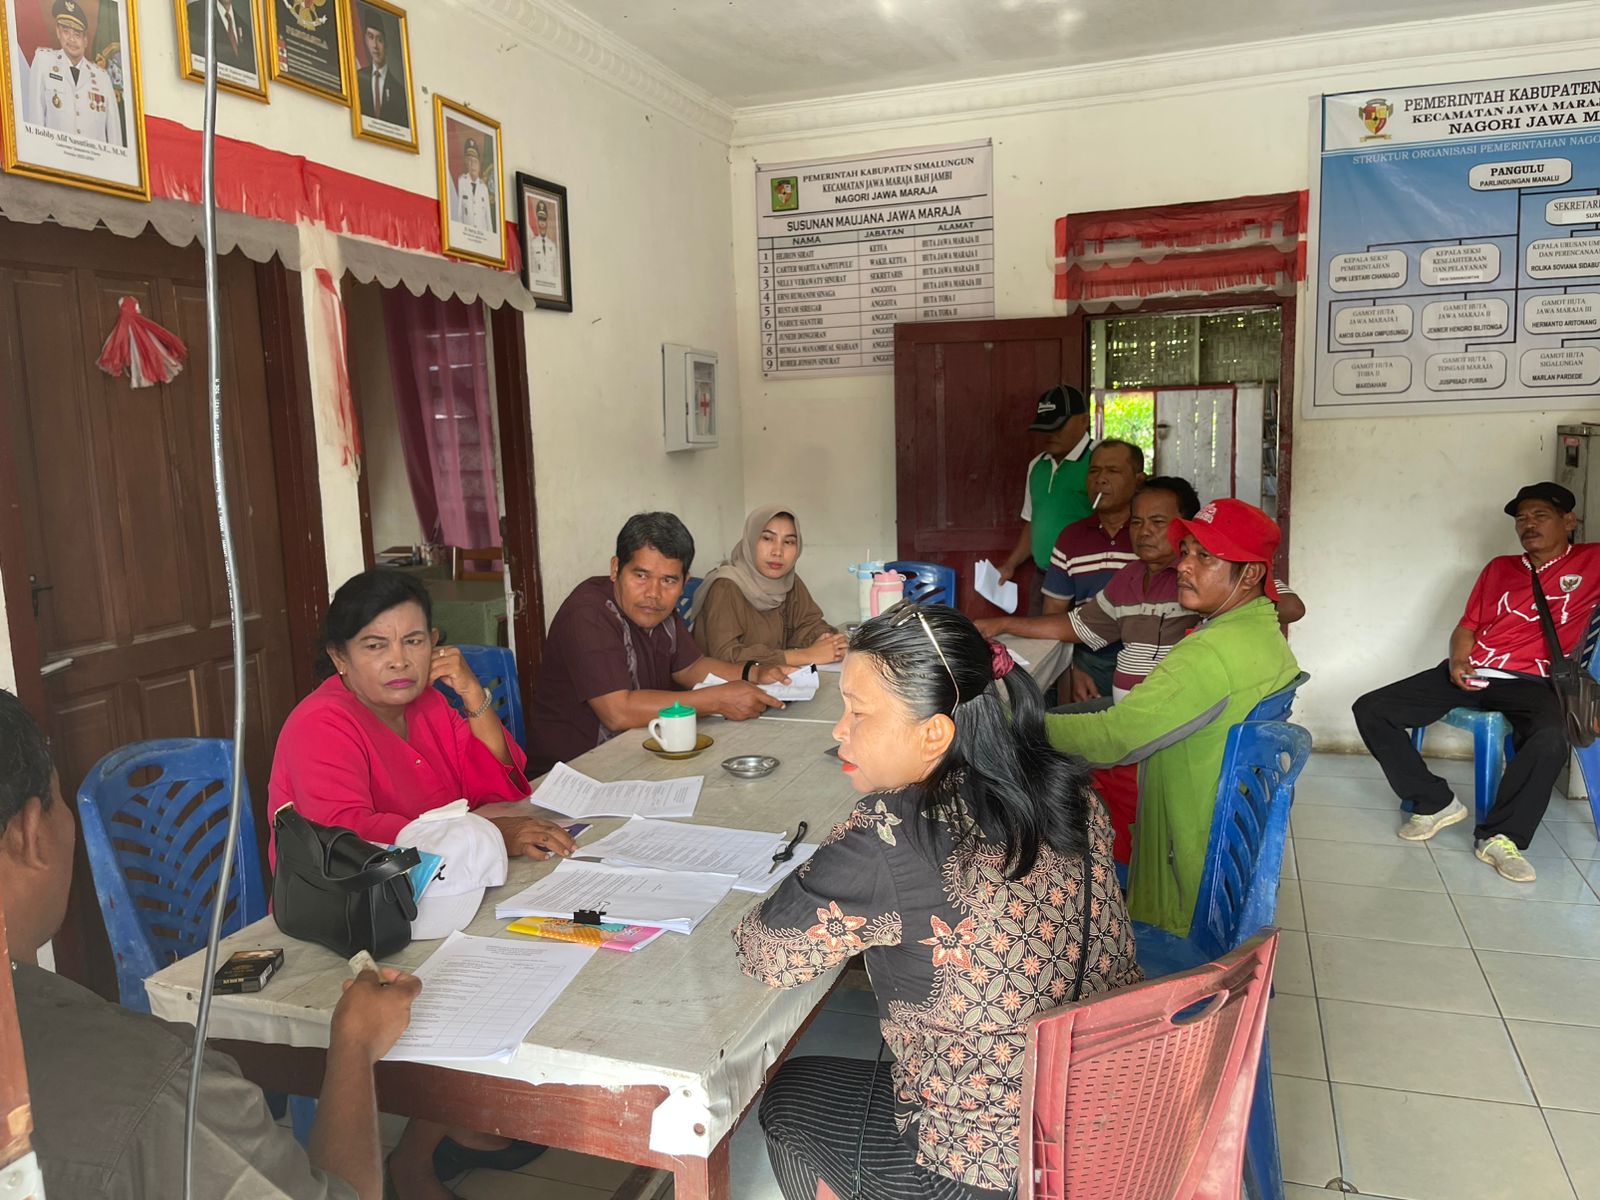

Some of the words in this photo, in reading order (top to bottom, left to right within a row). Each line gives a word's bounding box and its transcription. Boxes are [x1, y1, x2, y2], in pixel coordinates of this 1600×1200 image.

[1404, 88, 1504, 112] PEMERINTAH
[1510, 80, 1600, 102] KABUPATEN
[1412, 107, 1506, 123] KECAMATAN
[1507, 103, 1548, 115] JAWA
[1448, 118, 1520, 135] NAGORI
[1526, 114, 1576, 128] JAWA
[36, 128, 54, 140] Bobby
[1353, 152, 1409, 164] STRUKTUR
[1412, 146, 1477, 159] ORGANISASI
[1480, 138, 1567, 153] PEMERINTAHAN
[803, 170, 858, 183] PEMERINTAH
[860, 164, 912, 176] KABUPATEN
[914, 157, 974, 170] SIMALUNGUN
[1491, 164, 1544, 176] PANGULU
[822, 178, 865, 193] KECAMATAN
[866, 178, 884, 190] JAWA
[885, 175, 914, 186] MARAJA
[915, 174, 930, 184] BAH
[931, 171, 952, 183] JAMBI
[1480, 177, 1530, 187] PARLINDUNGAN
[835, 193, 870, 204] NAGORI
[872, 191, 898, 200] JAWA
[900, 186, 938, 197] MARAJA
[787, 218, 834, 232] SUSUNAN
[836, 214, 884, 228] MAUJANA
[887, 210, 916, 222] JAWA
[918, 205, 961, 219] MARAJA
[938, 222, 974, 231] ALAMAT
[864, 228, 904, 238] JABATAN
[792, 236, 821, 245] NAMA
[953, 236, 974, 245] MARAJA
[953, 250, 974, 259] MARAJA
[1340, 263, 1390, 271] PEMERINTAHAN
[764, 280, 769, 289] 3
[953, 279, 975, 287] MARAJA
[871, 286, 896, 294] ANGGOTA
[764, 293, 769, 302] 4
[871, 299, 897, 307] ANGGOTA
[764, 307, 770, 316] 5
[872, 313, 898, 321] ANGGOTA
[764, 320, 771, 329] 6
[766, 334, 773, 343] 7
[766, 347, 773, 356] 8
[766, 360, 773, 369] 9
